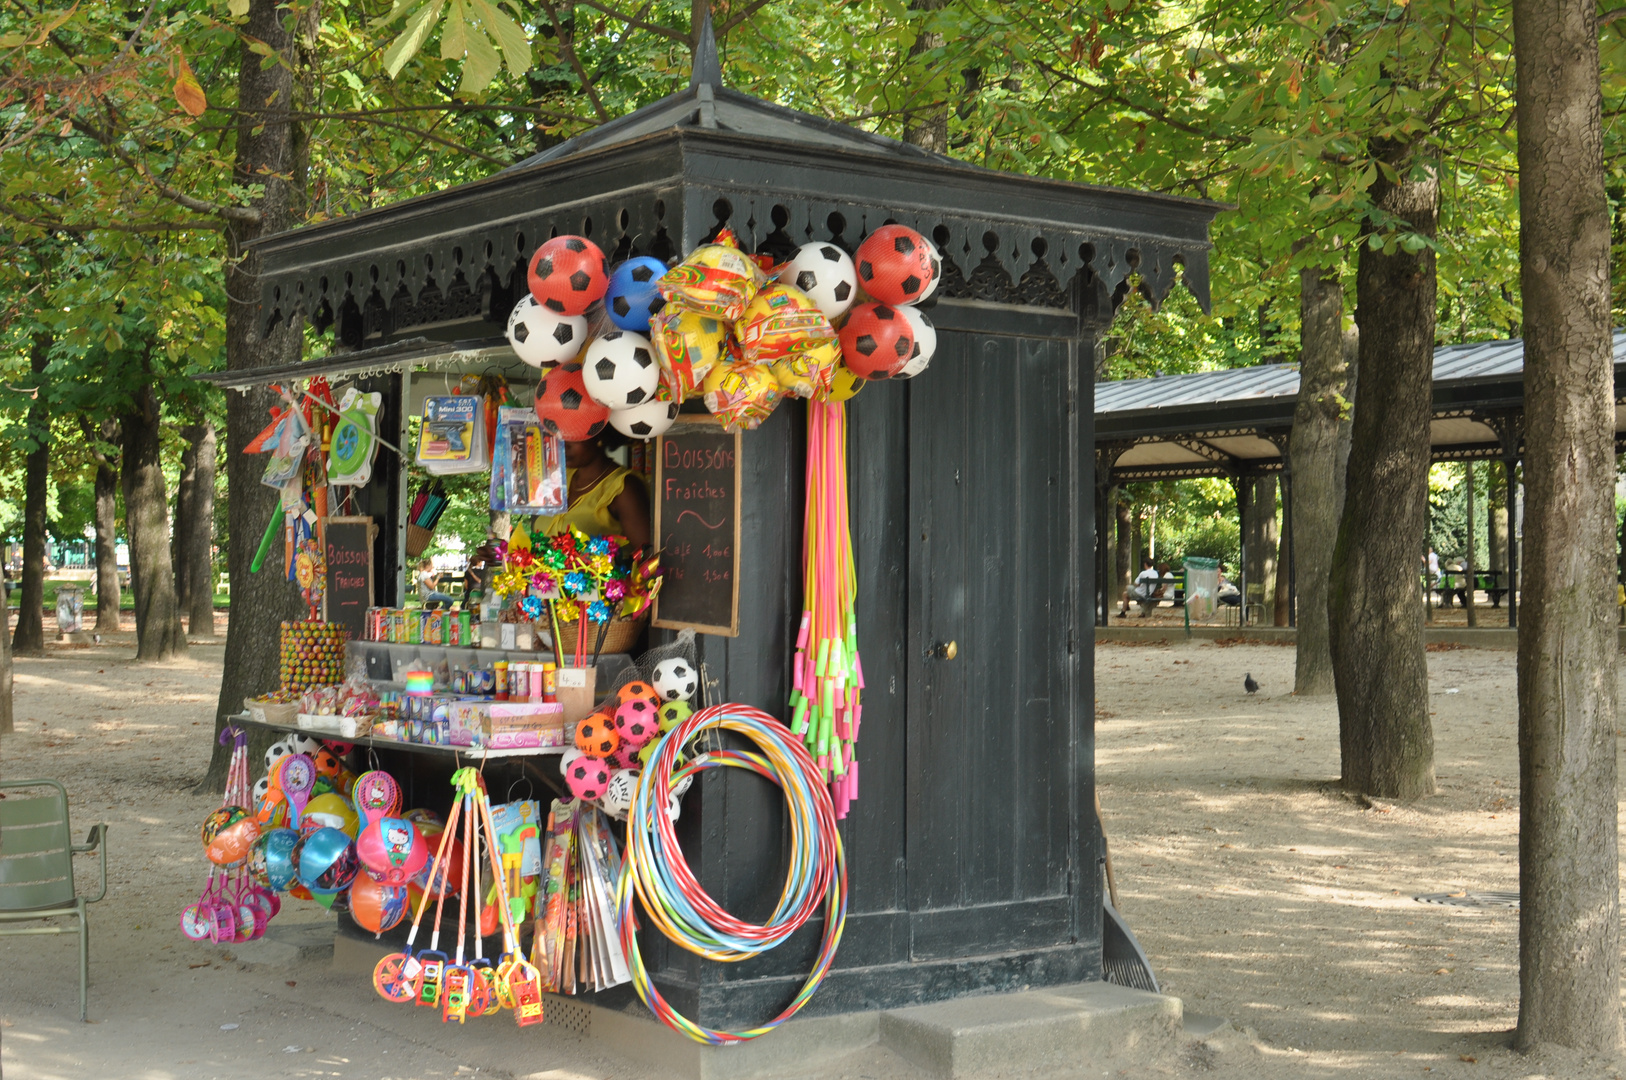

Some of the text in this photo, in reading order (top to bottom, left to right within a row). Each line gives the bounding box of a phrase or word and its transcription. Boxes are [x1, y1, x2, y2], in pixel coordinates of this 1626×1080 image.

[665, 440, 735, 470] Boissons
[665, 478, 726, 501] Fraîches
[665, 532, 692, 563] Café
